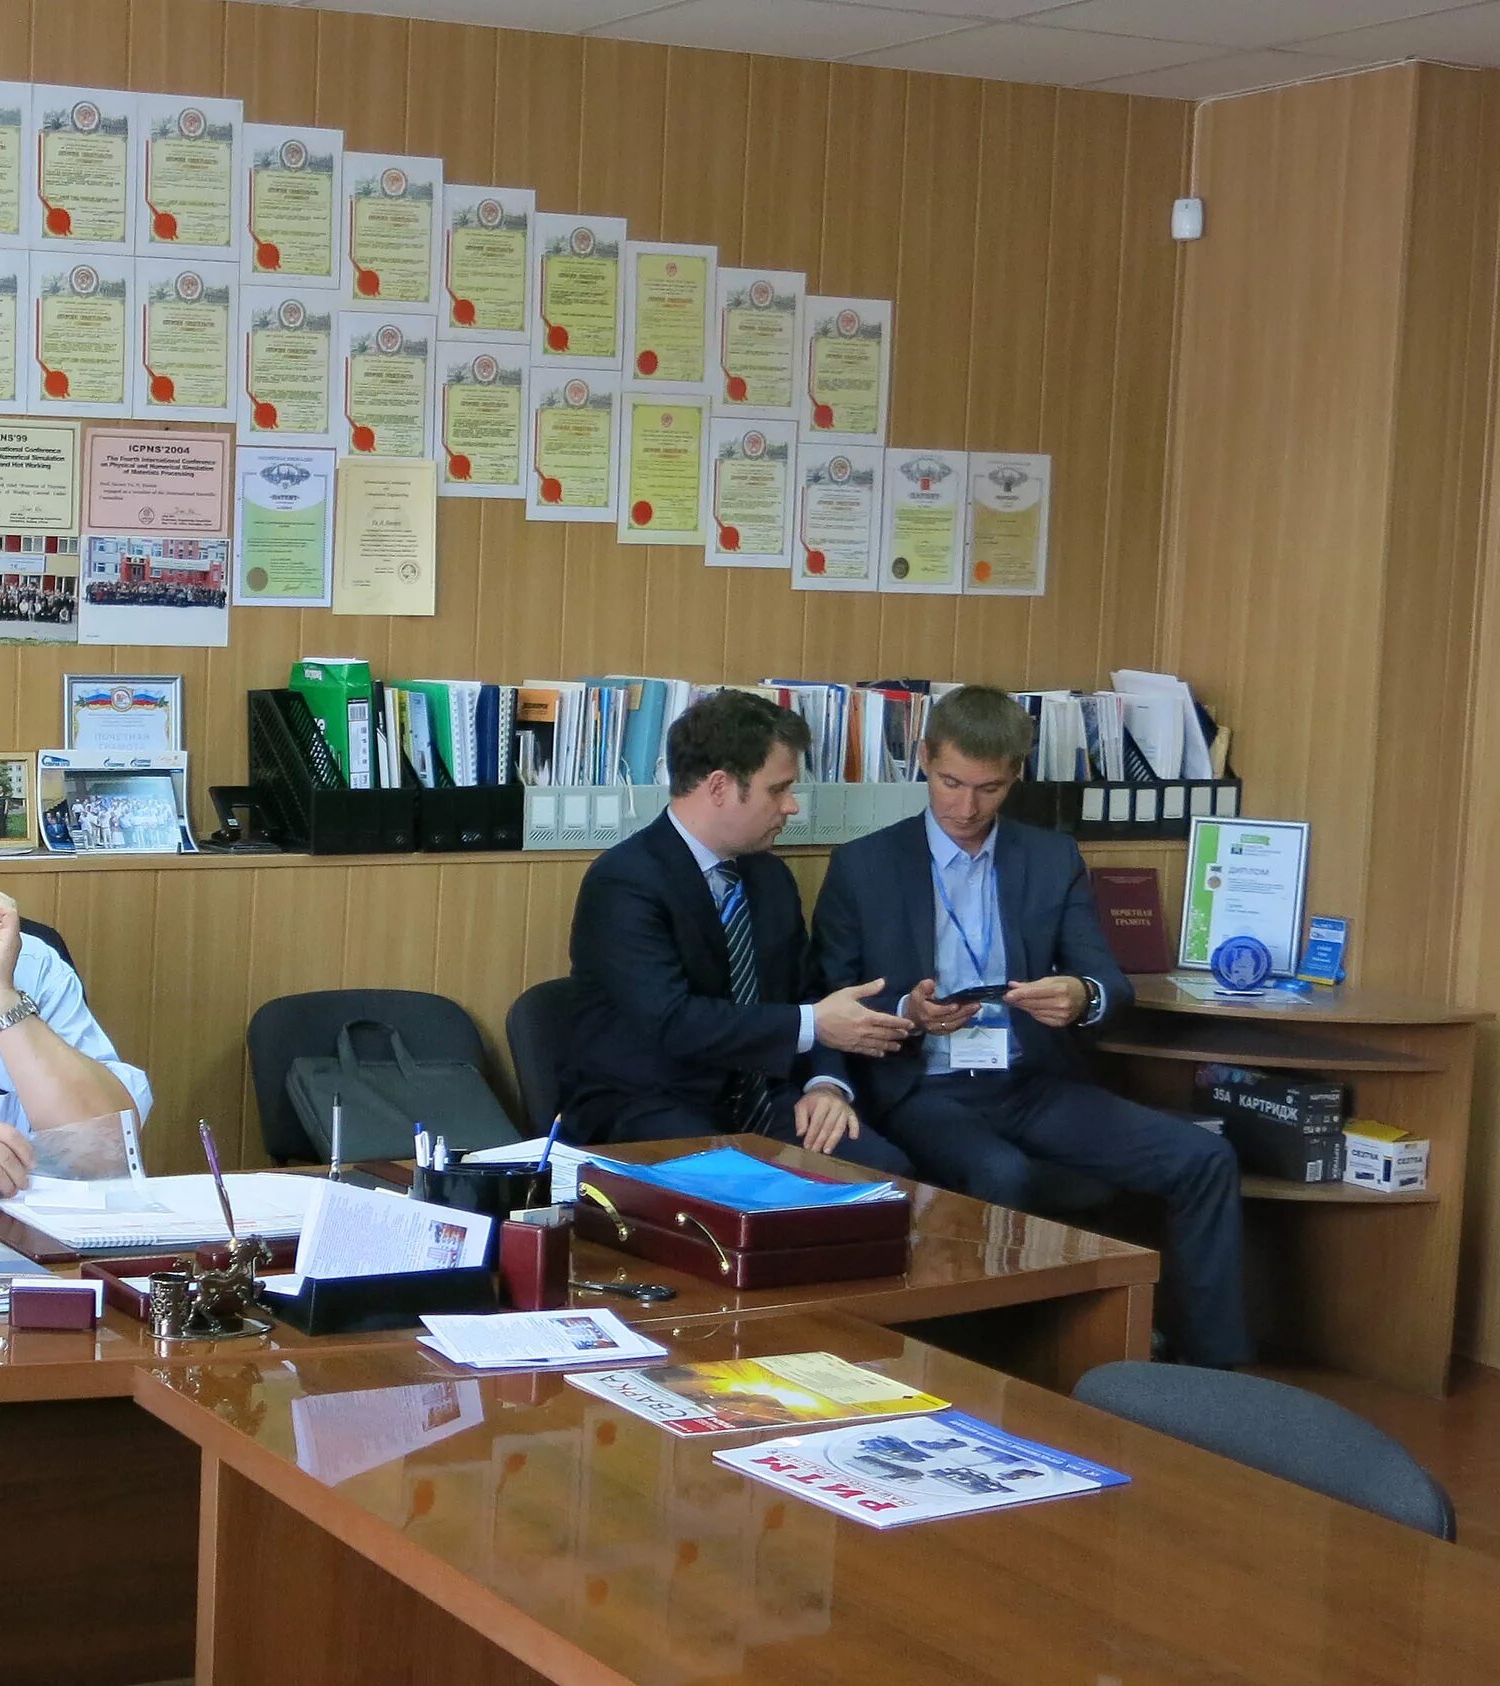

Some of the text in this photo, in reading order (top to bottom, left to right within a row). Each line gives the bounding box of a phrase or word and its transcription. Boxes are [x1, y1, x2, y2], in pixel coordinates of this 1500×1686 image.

[25, 446, 62, 454] Conference
[128, 445, 190, 454] ICPNS'2004
[31, 454, 66, 462] Simulation
[182, 458, 216, 466] Conference
[25, 462, 52, 470] Working
[1238, 1093, 1299, 1121] КАРТРИДЖ
[598, 1374, 689, 1418] СВАРКА
[749, 1455, 900, 1512] РИТМ
